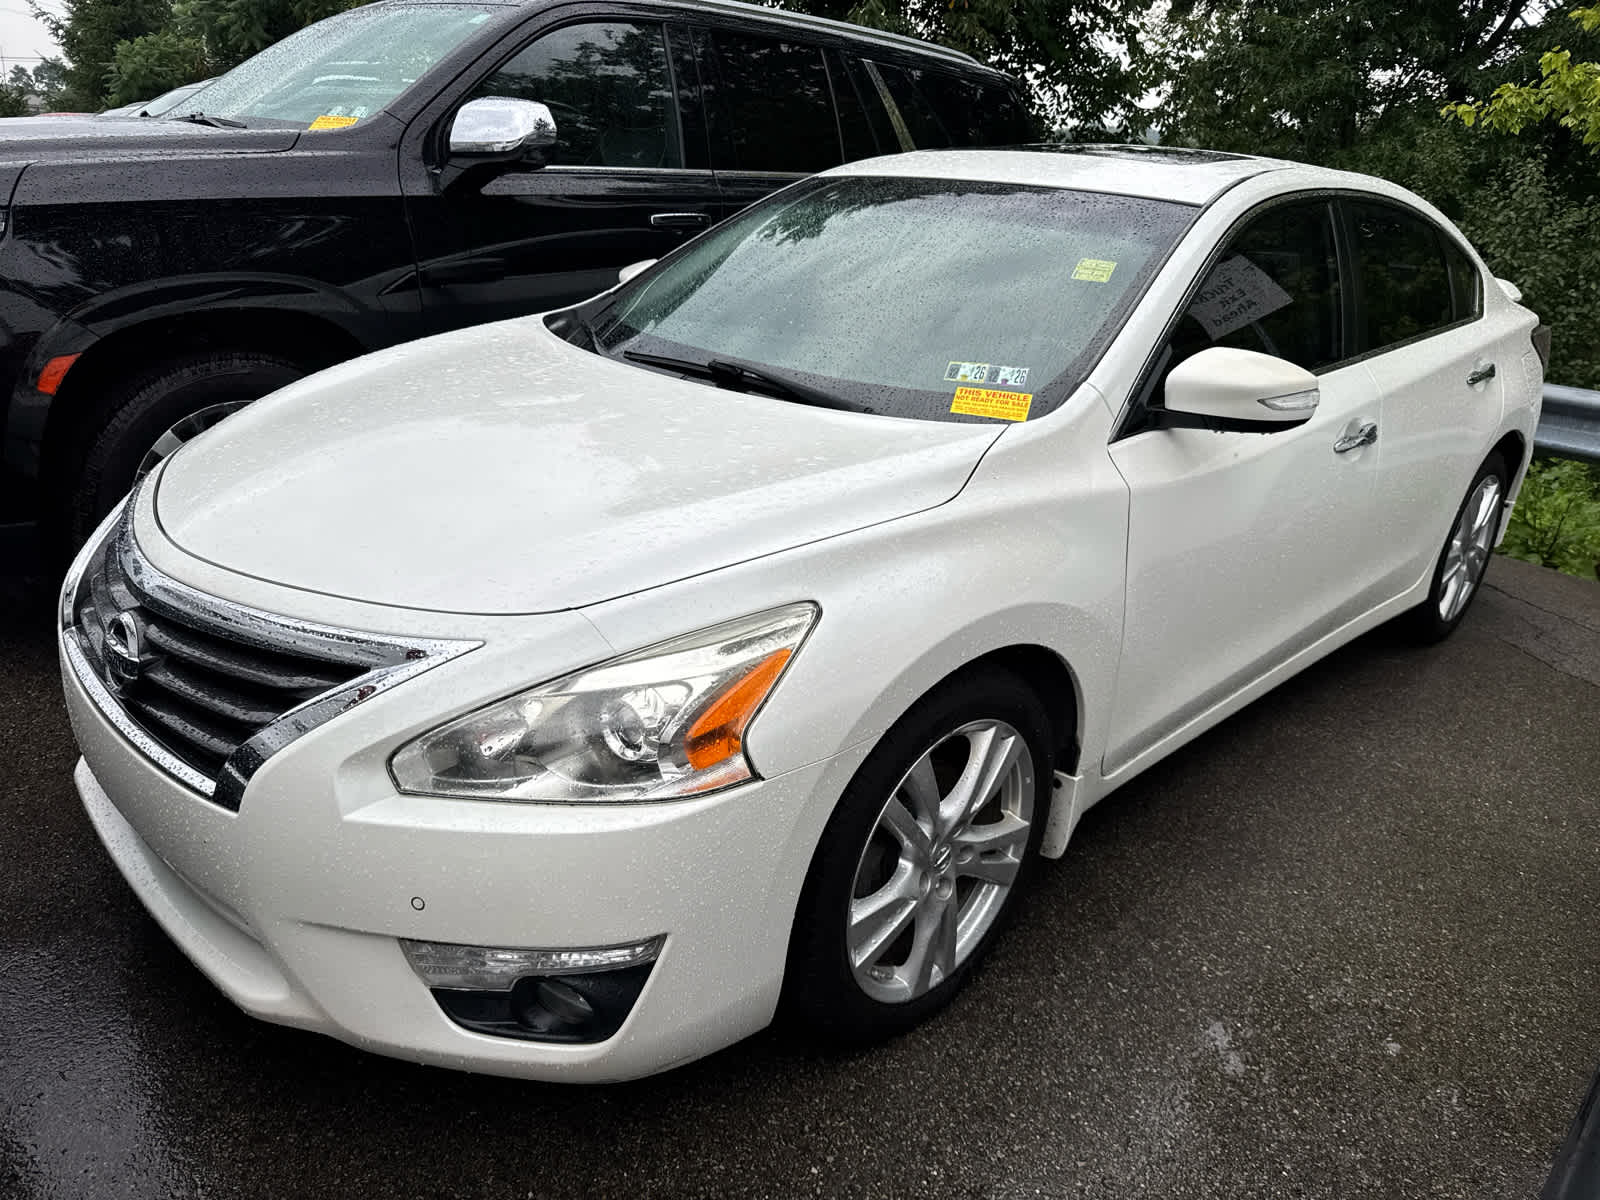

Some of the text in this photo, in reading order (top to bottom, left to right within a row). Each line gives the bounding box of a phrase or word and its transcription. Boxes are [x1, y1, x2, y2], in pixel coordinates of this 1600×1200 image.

[974, 366, 986, 380] 26
[1014, 369, 1027, 384] 26
[959, 388, 1030, 402] THIS VEHICLE
[971, 396, 993, 404] READY
